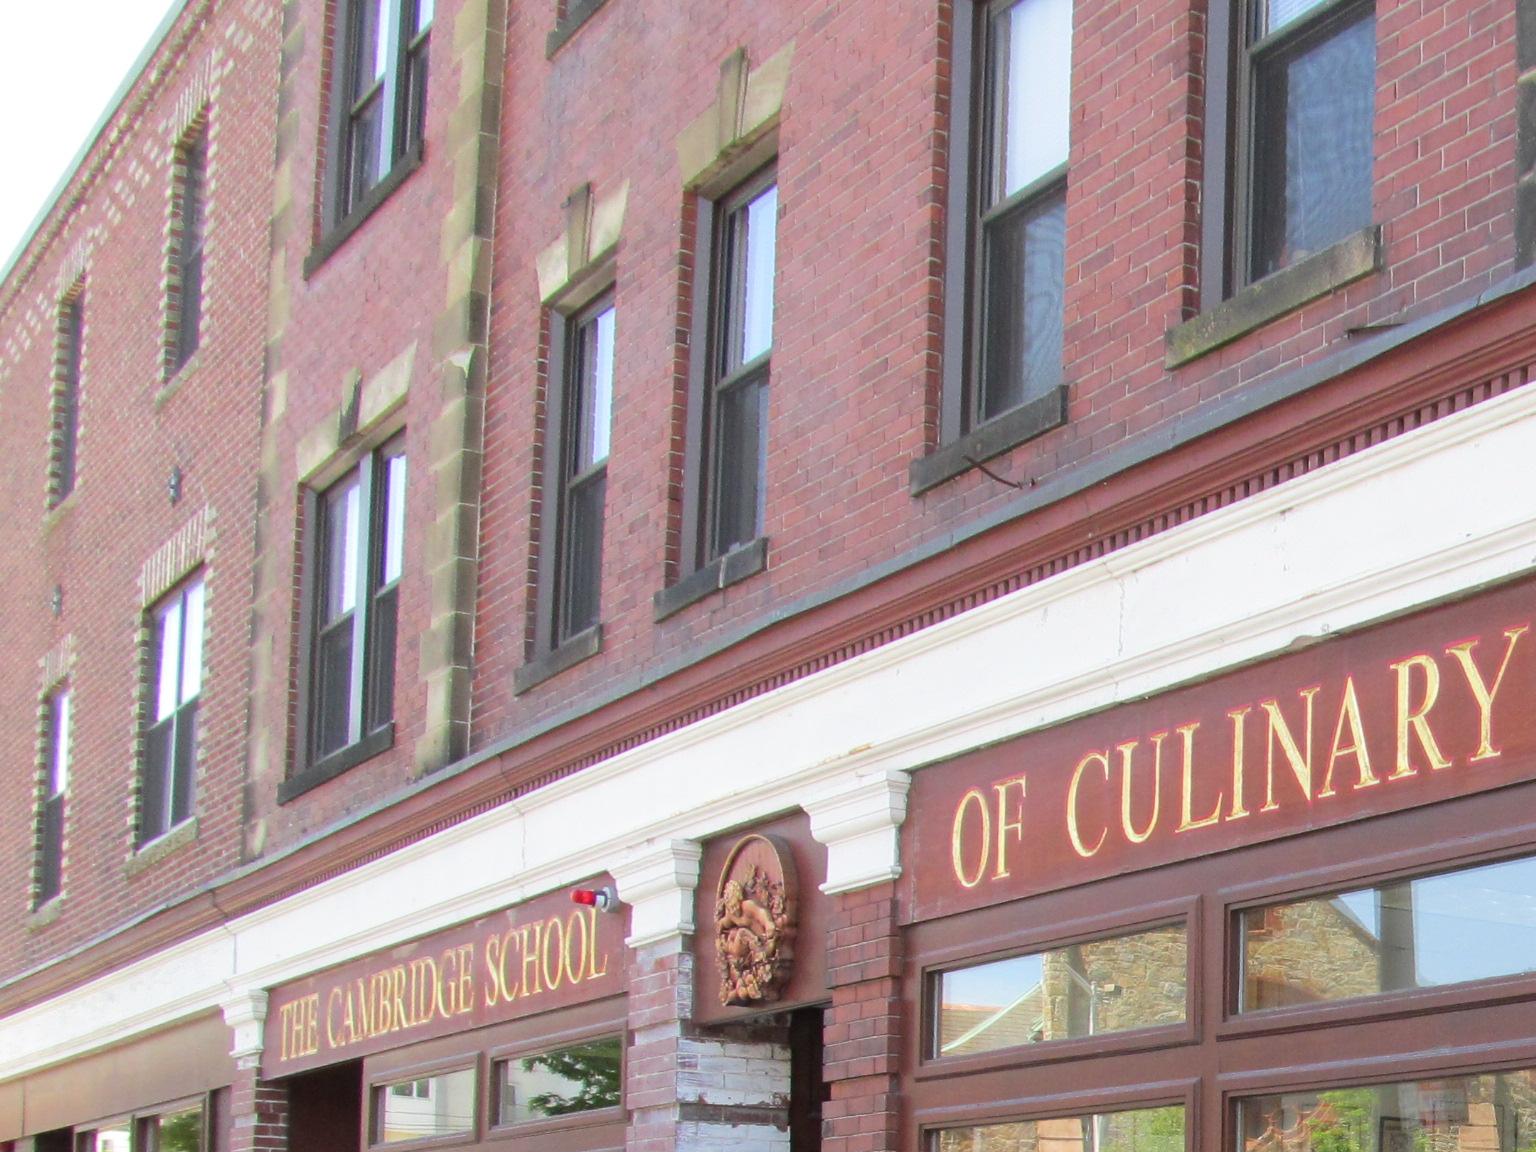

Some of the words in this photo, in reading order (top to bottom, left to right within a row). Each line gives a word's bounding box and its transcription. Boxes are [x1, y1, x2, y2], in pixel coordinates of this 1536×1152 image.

[951, 774, 1028, 891] OF
[1065, 624, 1530, 859] CULINARY
[279, 992, 320, 1062] THE
[326, 942, 475, 1049] CAMBRIDGE
[484, 906, 609, 1007] SCHOOL
